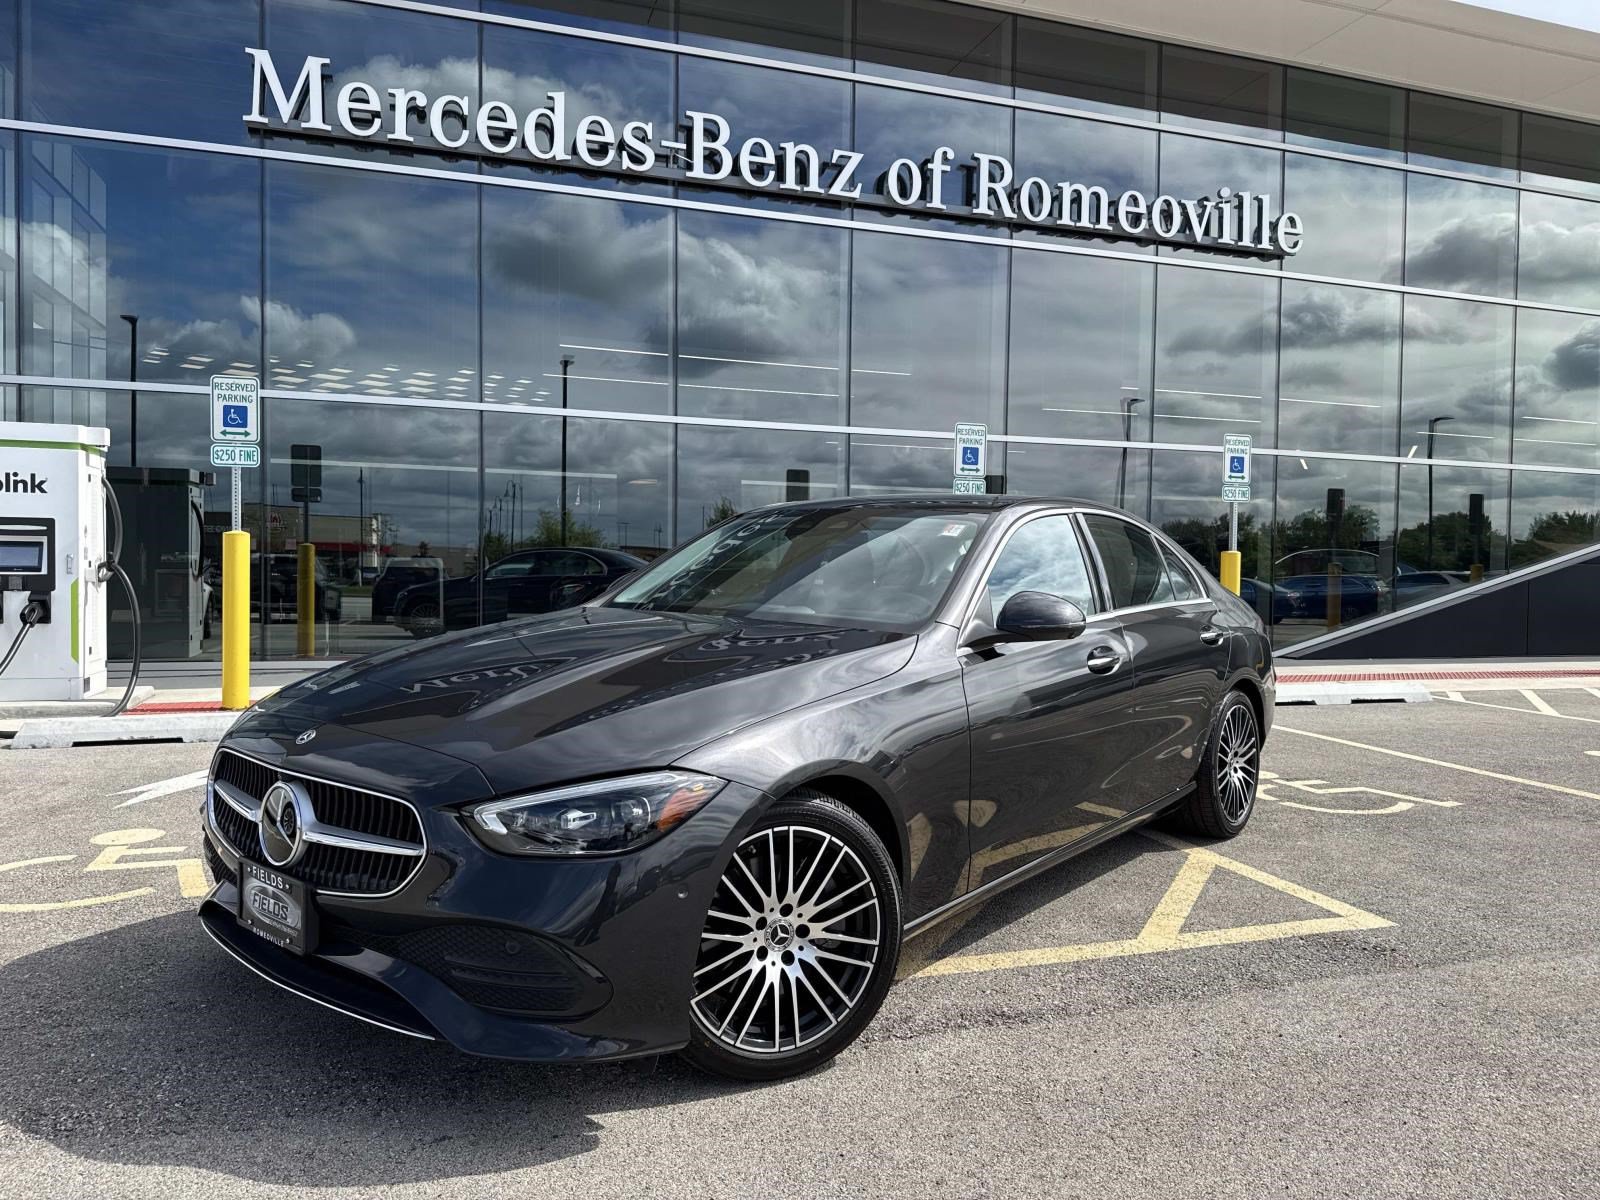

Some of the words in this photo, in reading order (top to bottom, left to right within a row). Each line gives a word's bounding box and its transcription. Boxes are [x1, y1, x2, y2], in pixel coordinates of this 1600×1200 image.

[242, 47, 864, 199] Mercedes-Benz
[887, 146, 955, 210] of
[972, 152, 1304, 254] Romeoville
[214, 382, 256, 392] RESERVED
[217, 394, 253, 403] PARKING
[958, 428, 985, 437] RESERVED
[959, 437, 983, 446] PARKING
[1226, 438, 1249, 447] RESERVED
[214, 449, 236, 462] $250
[239, 450, 257, 462] FINE
[1227, 447, 1248, 455] PARKING
[0, 472, 48, 494] link
[955, 482, 970, 493] $250
[971, 483, 984, 494] FINE
[1224, 488, 1237, 499] $250
[1238, 489, 1249, 500] FINE
[252, 866, 284, 889] FIELDS
[252, 892, 289, 921] FIELDS
[252, 927, 285, 948] ROMEOVILLE
